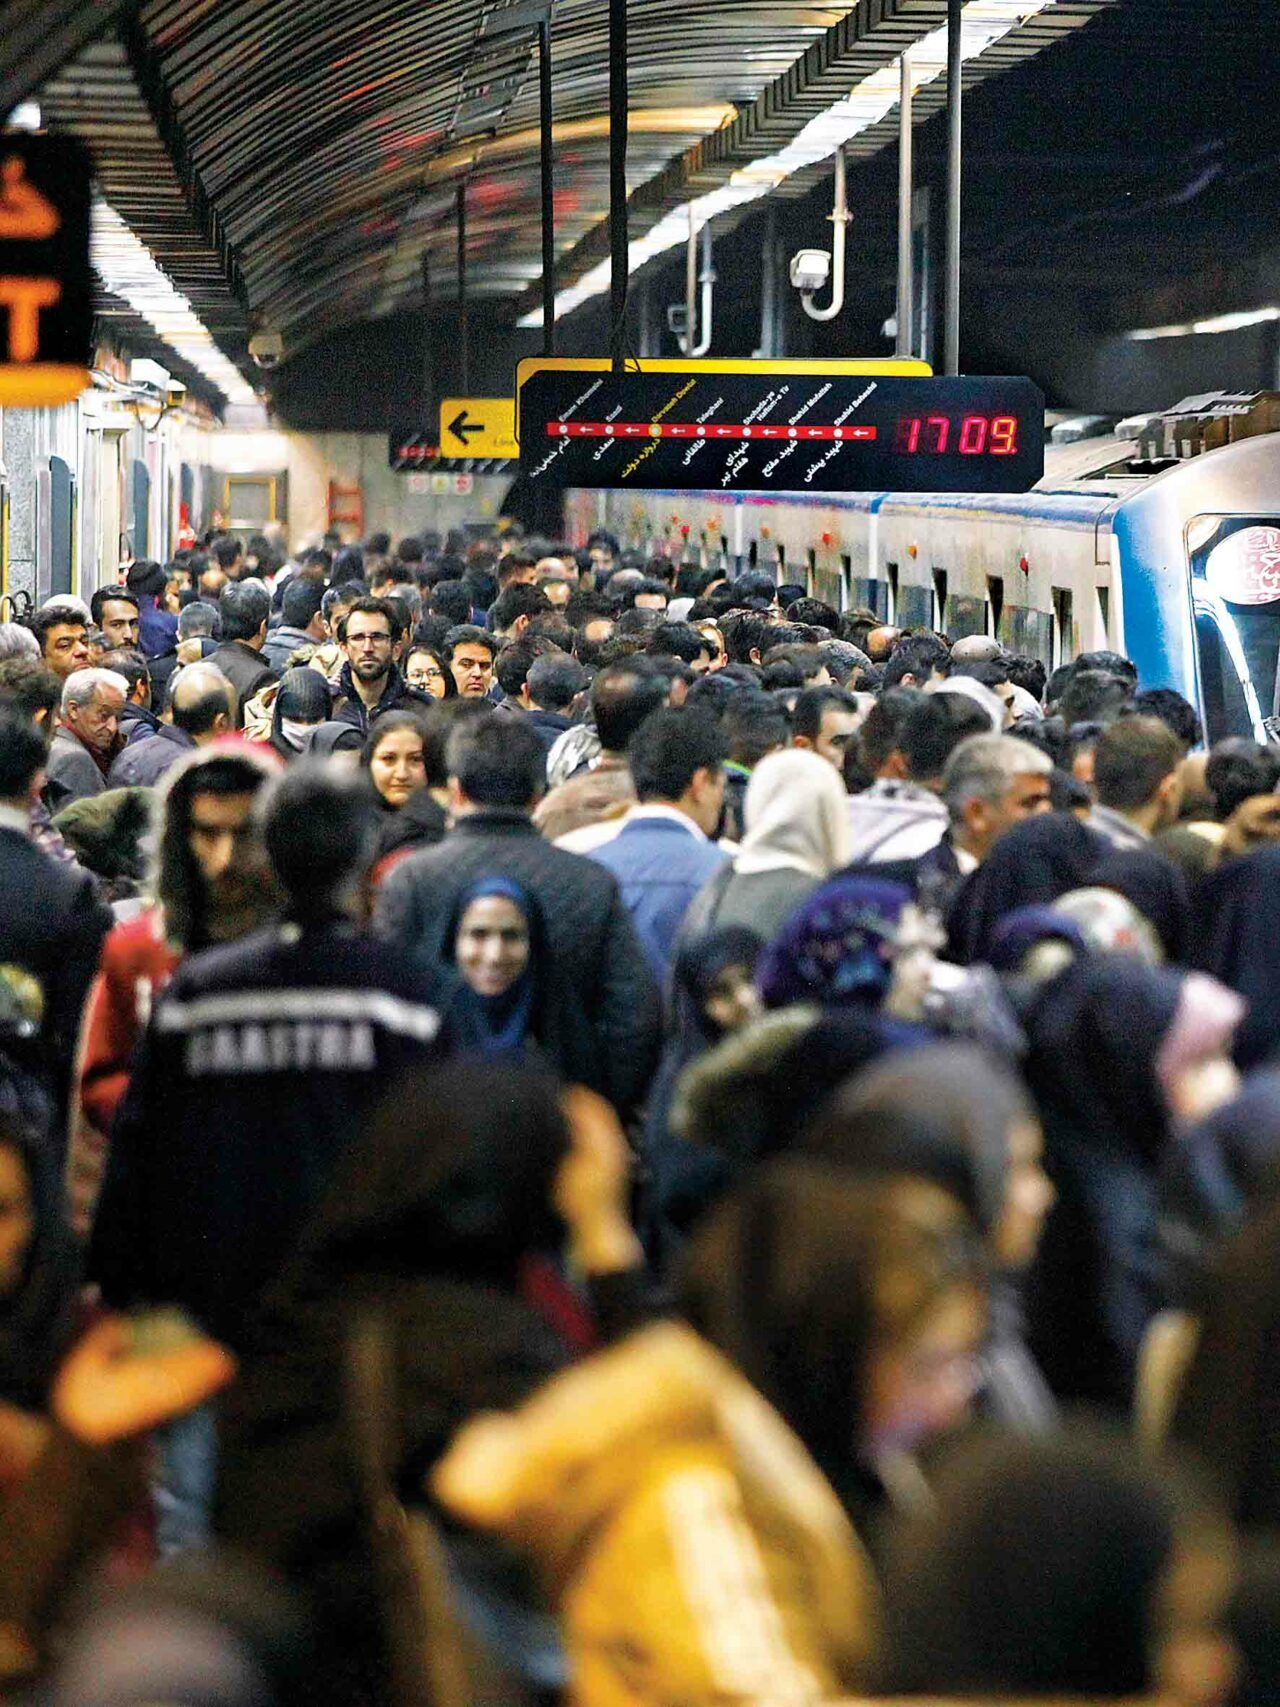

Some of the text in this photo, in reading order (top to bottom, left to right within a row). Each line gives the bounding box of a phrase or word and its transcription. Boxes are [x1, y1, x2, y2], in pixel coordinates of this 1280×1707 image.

[696, 397, 724, 424] Taleghani
[788, 382, 833, 426] Shahid Mofatteh
[834, 381, 878, 427] Shahid Beheshti
[593, 437, 615, 461] سعدی
[621, 438, 661, 478] دروازه دولت
[682, 439, 706, 466] طالقانی
[725, 441, 750, 467] شهدای
[761, 439, 798, 478] شهید مفتح
[804, 439, 844, 483] شهید بهشتی
[721, 457, 749, 487] هفتم تیر
